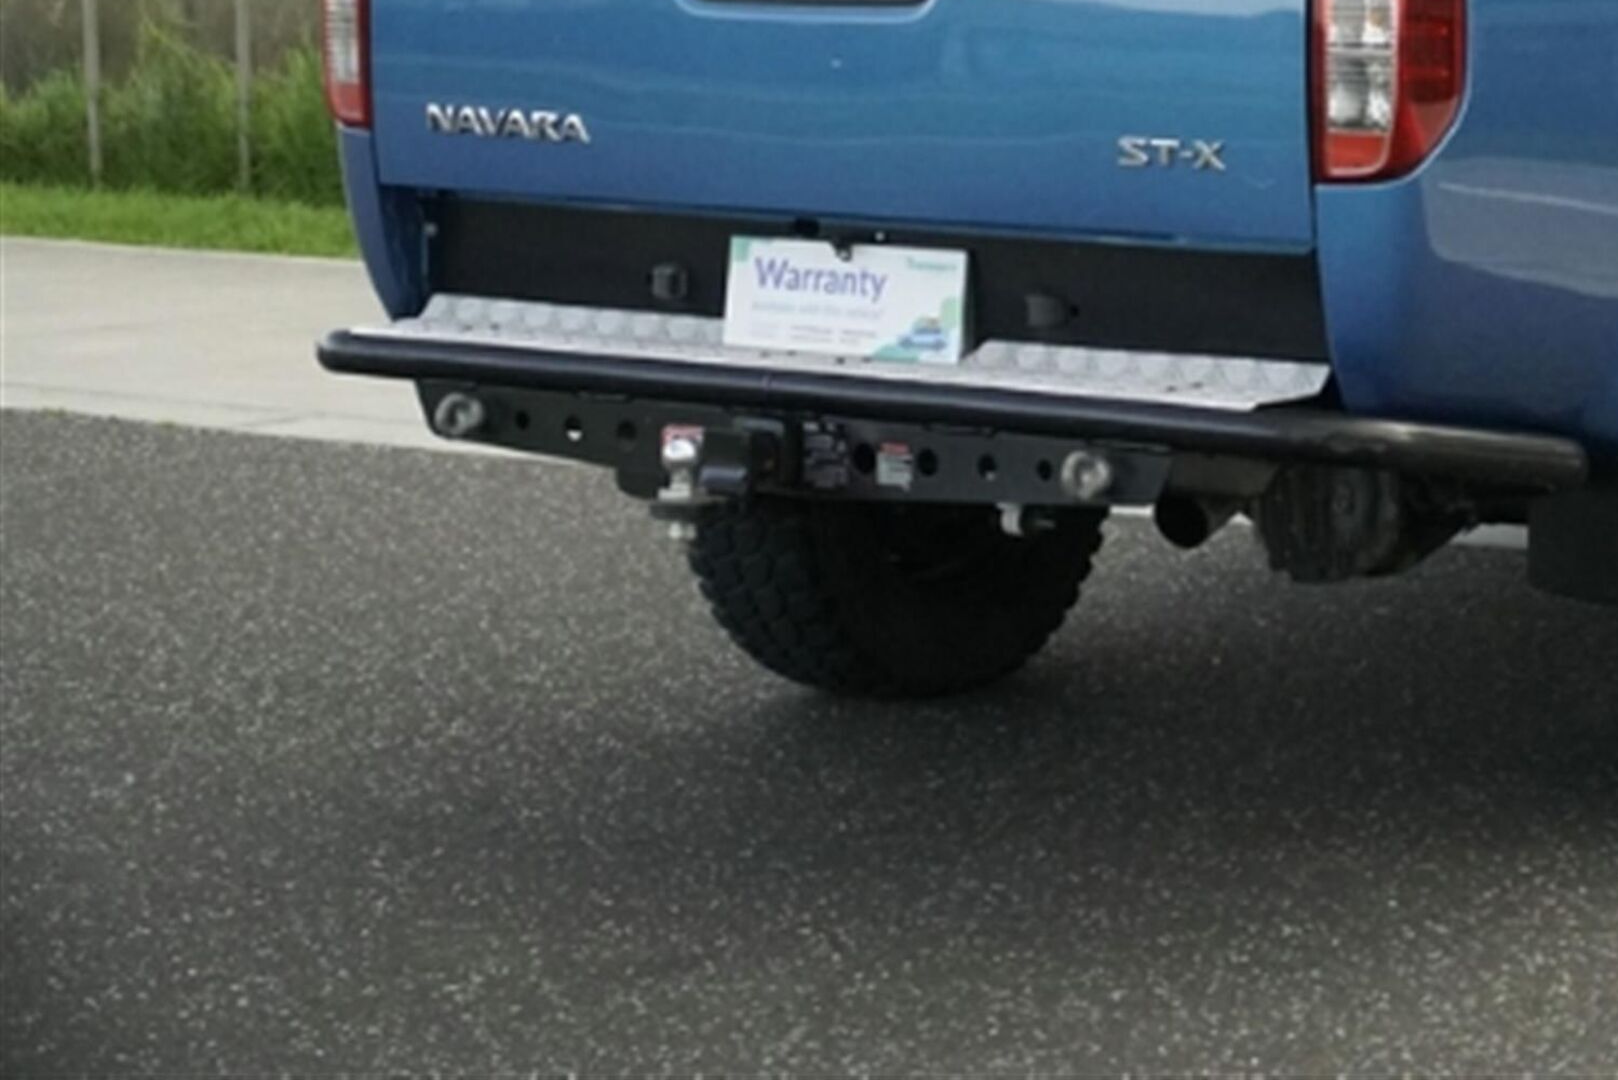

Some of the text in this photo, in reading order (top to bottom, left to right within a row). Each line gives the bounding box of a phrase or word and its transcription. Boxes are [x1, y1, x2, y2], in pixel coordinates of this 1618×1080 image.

[426, 102, 591, 144] NAVARA
[1117, 135, 1226, 170] ST-X
[754, 257, 888, 303] Warranty
